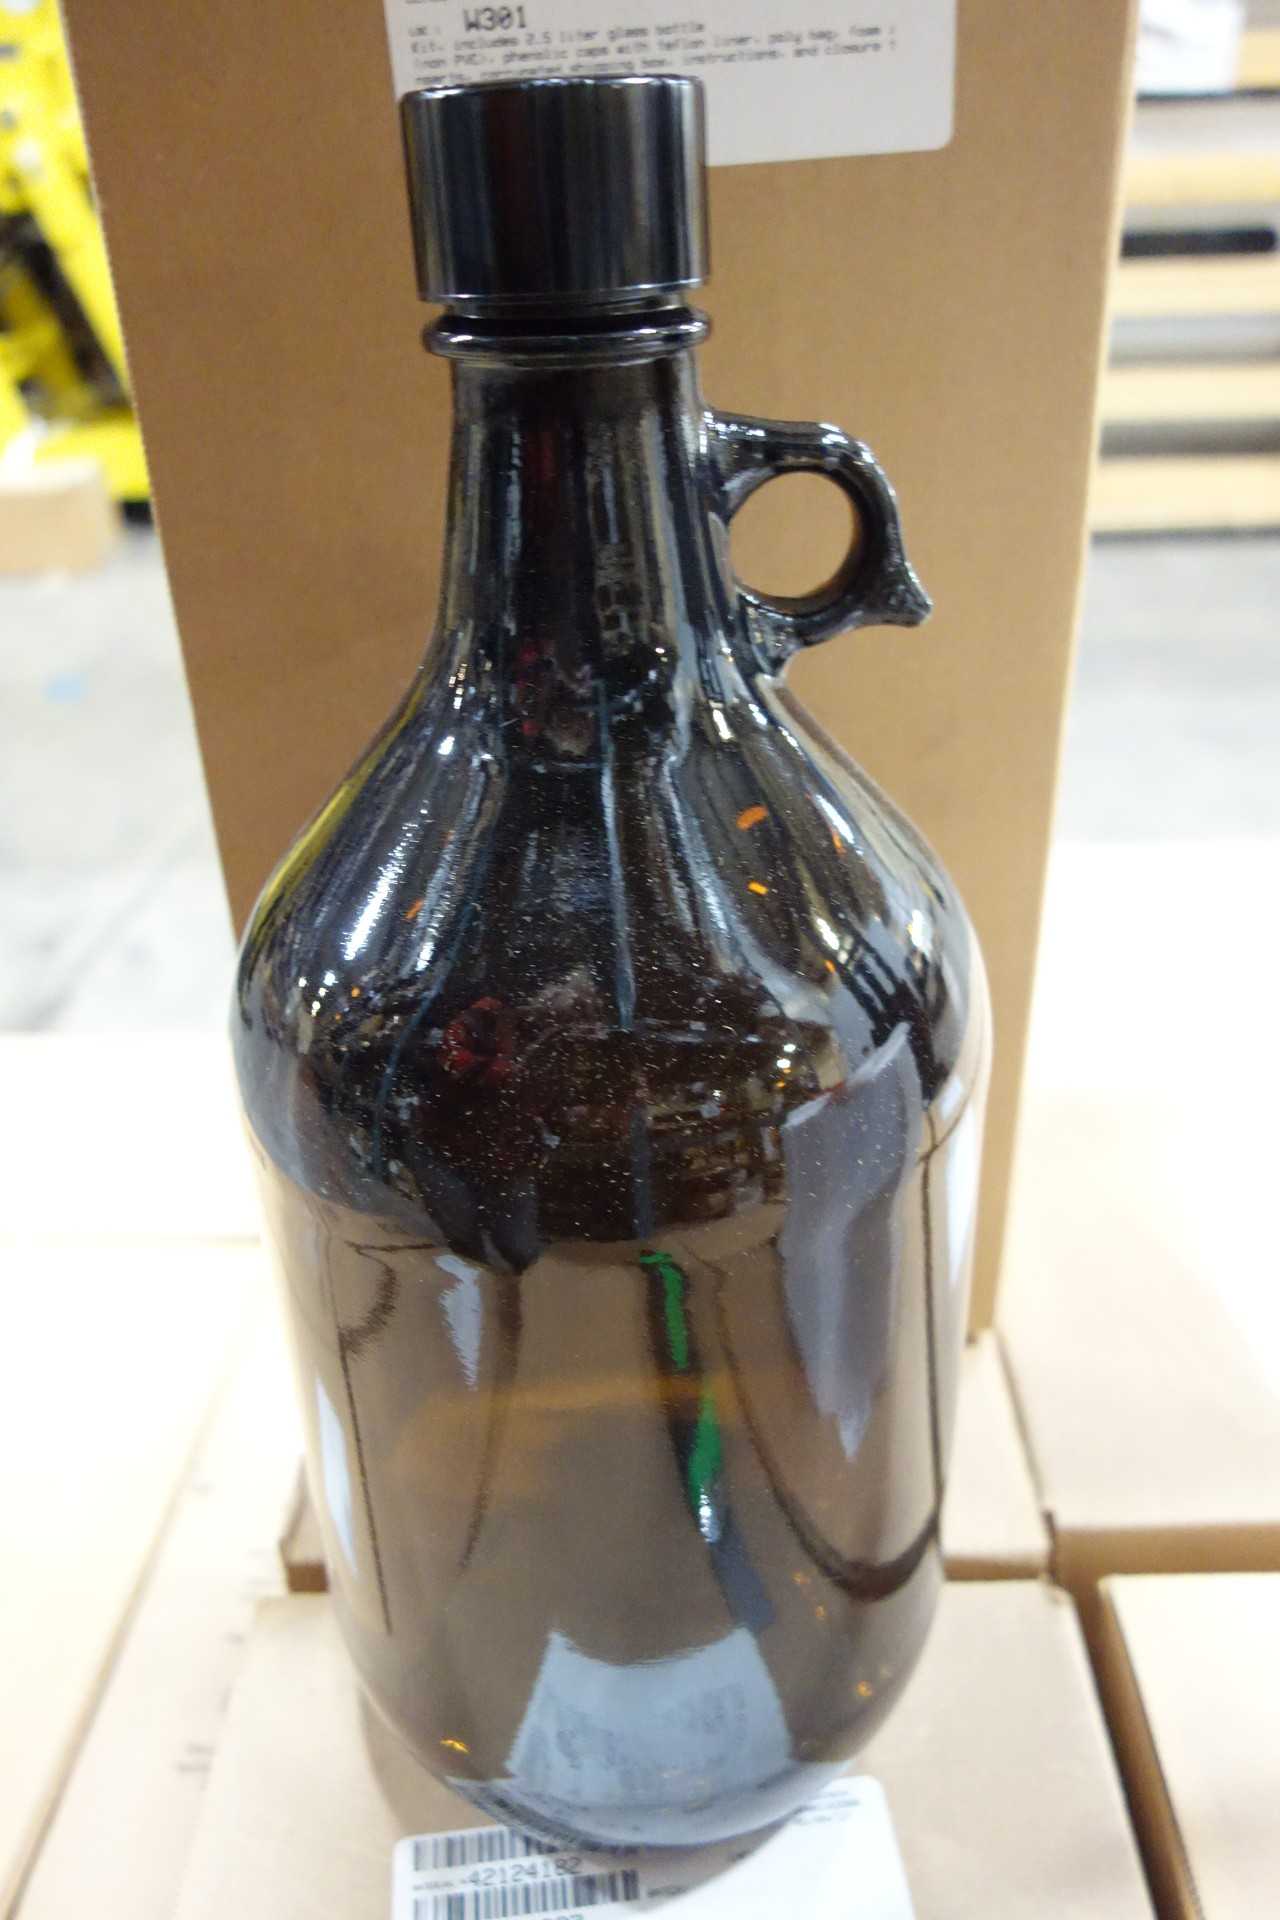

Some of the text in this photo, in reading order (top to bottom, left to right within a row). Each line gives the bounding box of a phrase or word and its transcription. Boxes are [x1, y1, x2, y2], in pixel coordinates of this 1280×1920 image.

[463, 5, 527, 32] W301
[525, 32, 551, 46] 2.5
[559, 31, 600, 44] liter
